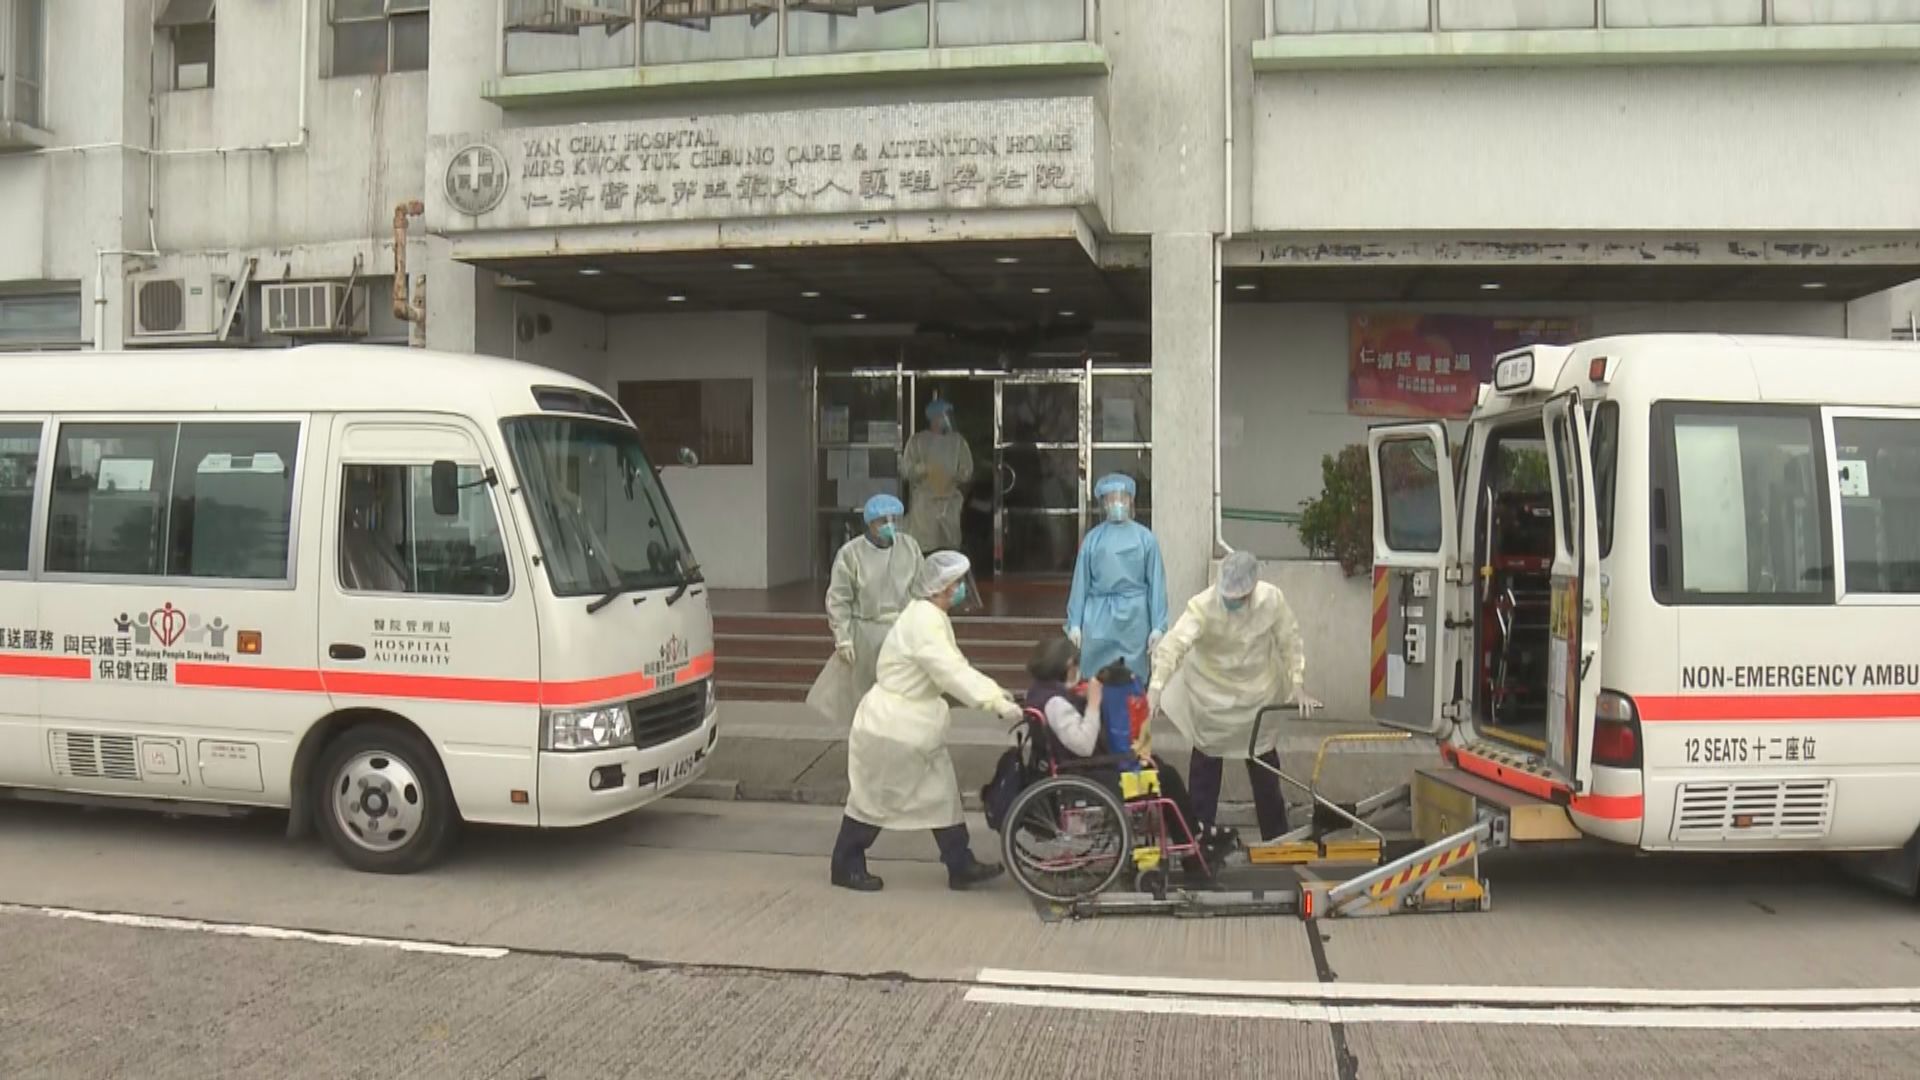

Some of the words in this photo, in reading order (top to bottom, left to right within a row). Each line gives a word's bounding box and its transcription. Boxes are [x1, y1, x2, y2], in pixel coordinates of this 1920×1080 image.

[523, 138, 560, 158] YAN
[568, 134, 616, 154] CHAI
[624, 128, 719, 151] HOSPITAL
[522, 159, 564, 179] MRS
[573, 156, 631, 176] KWOK
[639, 152, 680, 171] YUK
[786, 143, 842, 165] CARE
[852, 142, 867, 161] &
[878, 136, 998, 159] ATTENTION
[1006, 132, 1073, 154] HOME
[374, 640, 448, 652] HOSPITAL
[374, 652, 450, 665] AUTHORITY
[98, 660, 168, 682] 保健安康
[1682, 664, 1857, 688] NON-EMERGENCY
[1863, 664, 1920, 686] AMBU
[1685, 738, 1700, 762] 12
[1704, 738, 1748, 762] SEATS
[1752, 736, 1816, 761] 十二座位
